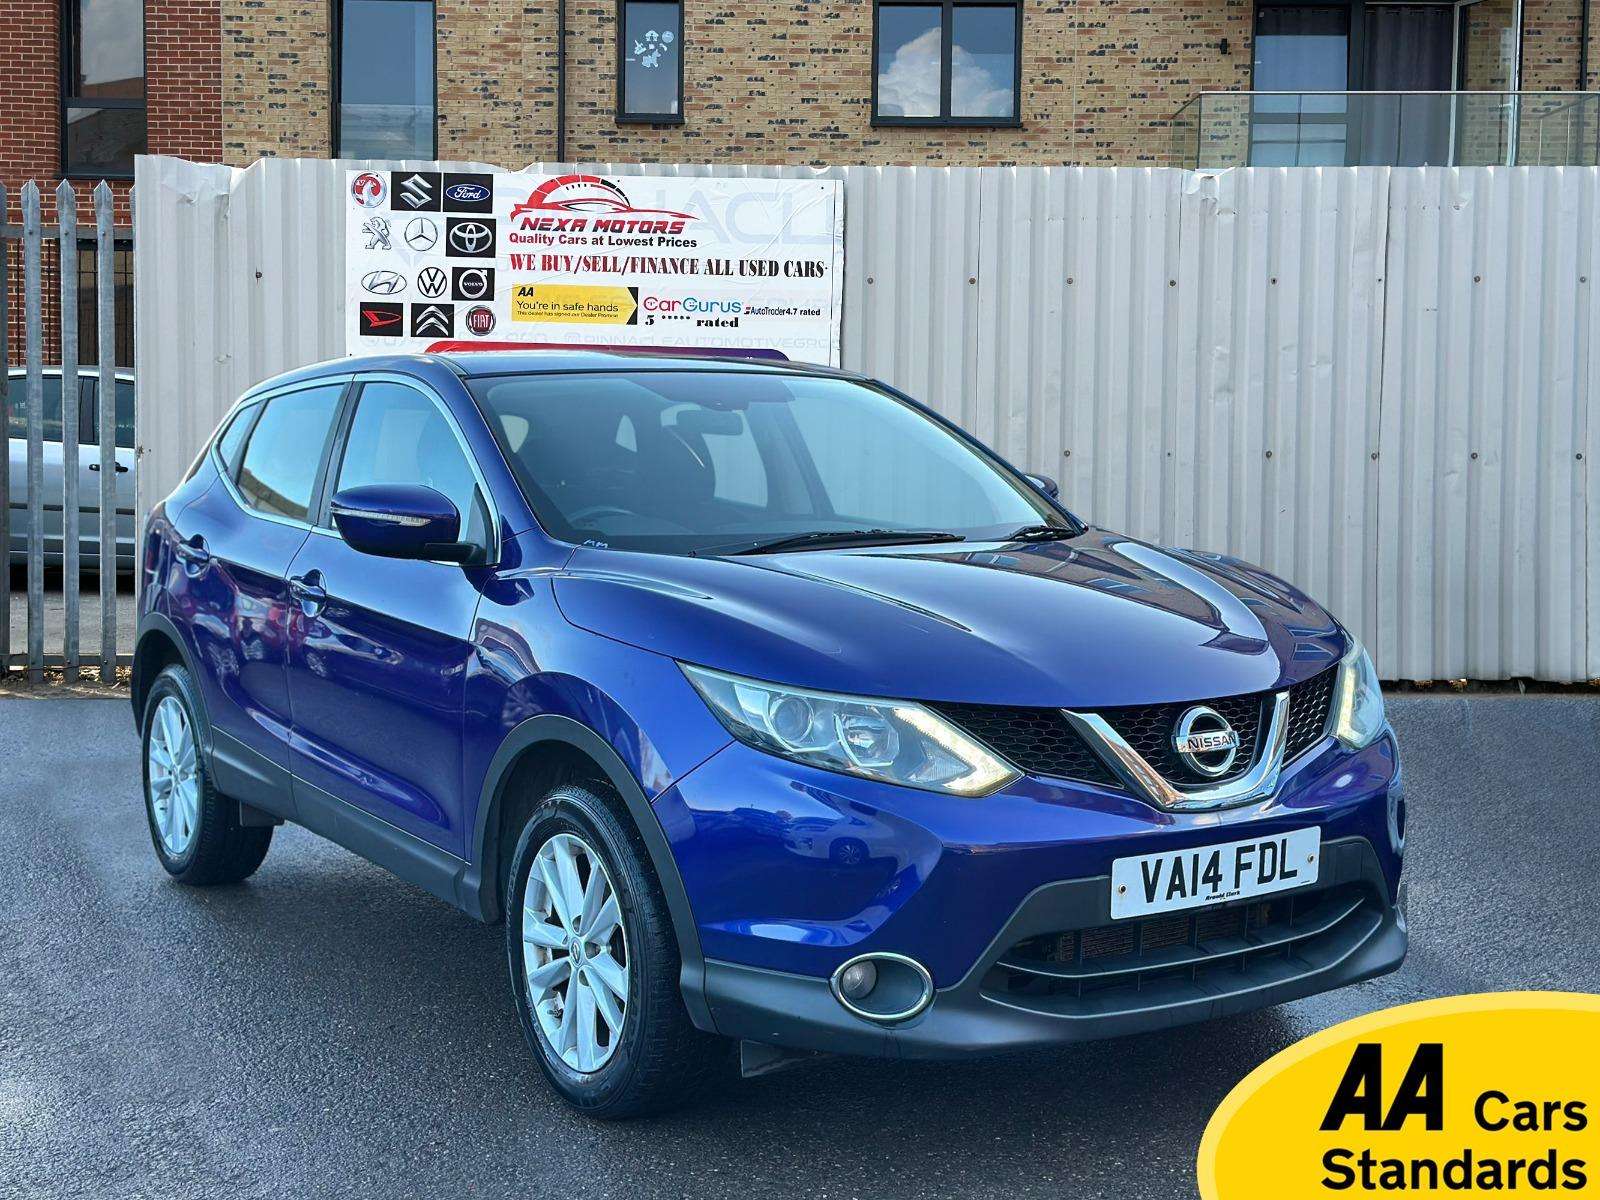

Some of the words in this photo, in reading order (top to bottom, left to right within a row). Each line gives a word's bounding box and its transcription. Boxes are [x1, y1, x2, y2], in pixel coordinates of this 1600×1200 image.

[454, 186, 482, 199] Ford
[520, 217, 588, 232] NEXA
[592, 219, 685, 234] MOTORS
[509, 232, 554, 246] Quality
[558, 234, 587, 244] Cars
[591, 235, 604, 245] at
[608, 236, 654, 246] Lowest
[657, 236, 697, 247] Prices
[509, 253, 536, 271] WE
[541, 254, 699, 275] BUY/SELL/FINANCE
[704, 258, 733, 276] ALL
[739, 259, 779, 276] USED
[518, 287, 534, 297] AA
[517, 301, 549, 311] You're
[551, 302, 561, 311] in
[563, 302, 585, 312] safe
[587, 304, 619, 312] hands
[643, 296, 742, 313] CarGurus
[799, 308, 821, 316] rated
[473, 315, 490, 328] FIAT
[645, 314, 655, 326] 5
[696, 317, 739, 328] rated
[1187, 734, 1236, 750] NISSAN
[1141, 849, 1223, 904] VA14
[1234, 838, 1298, 889] FDL
